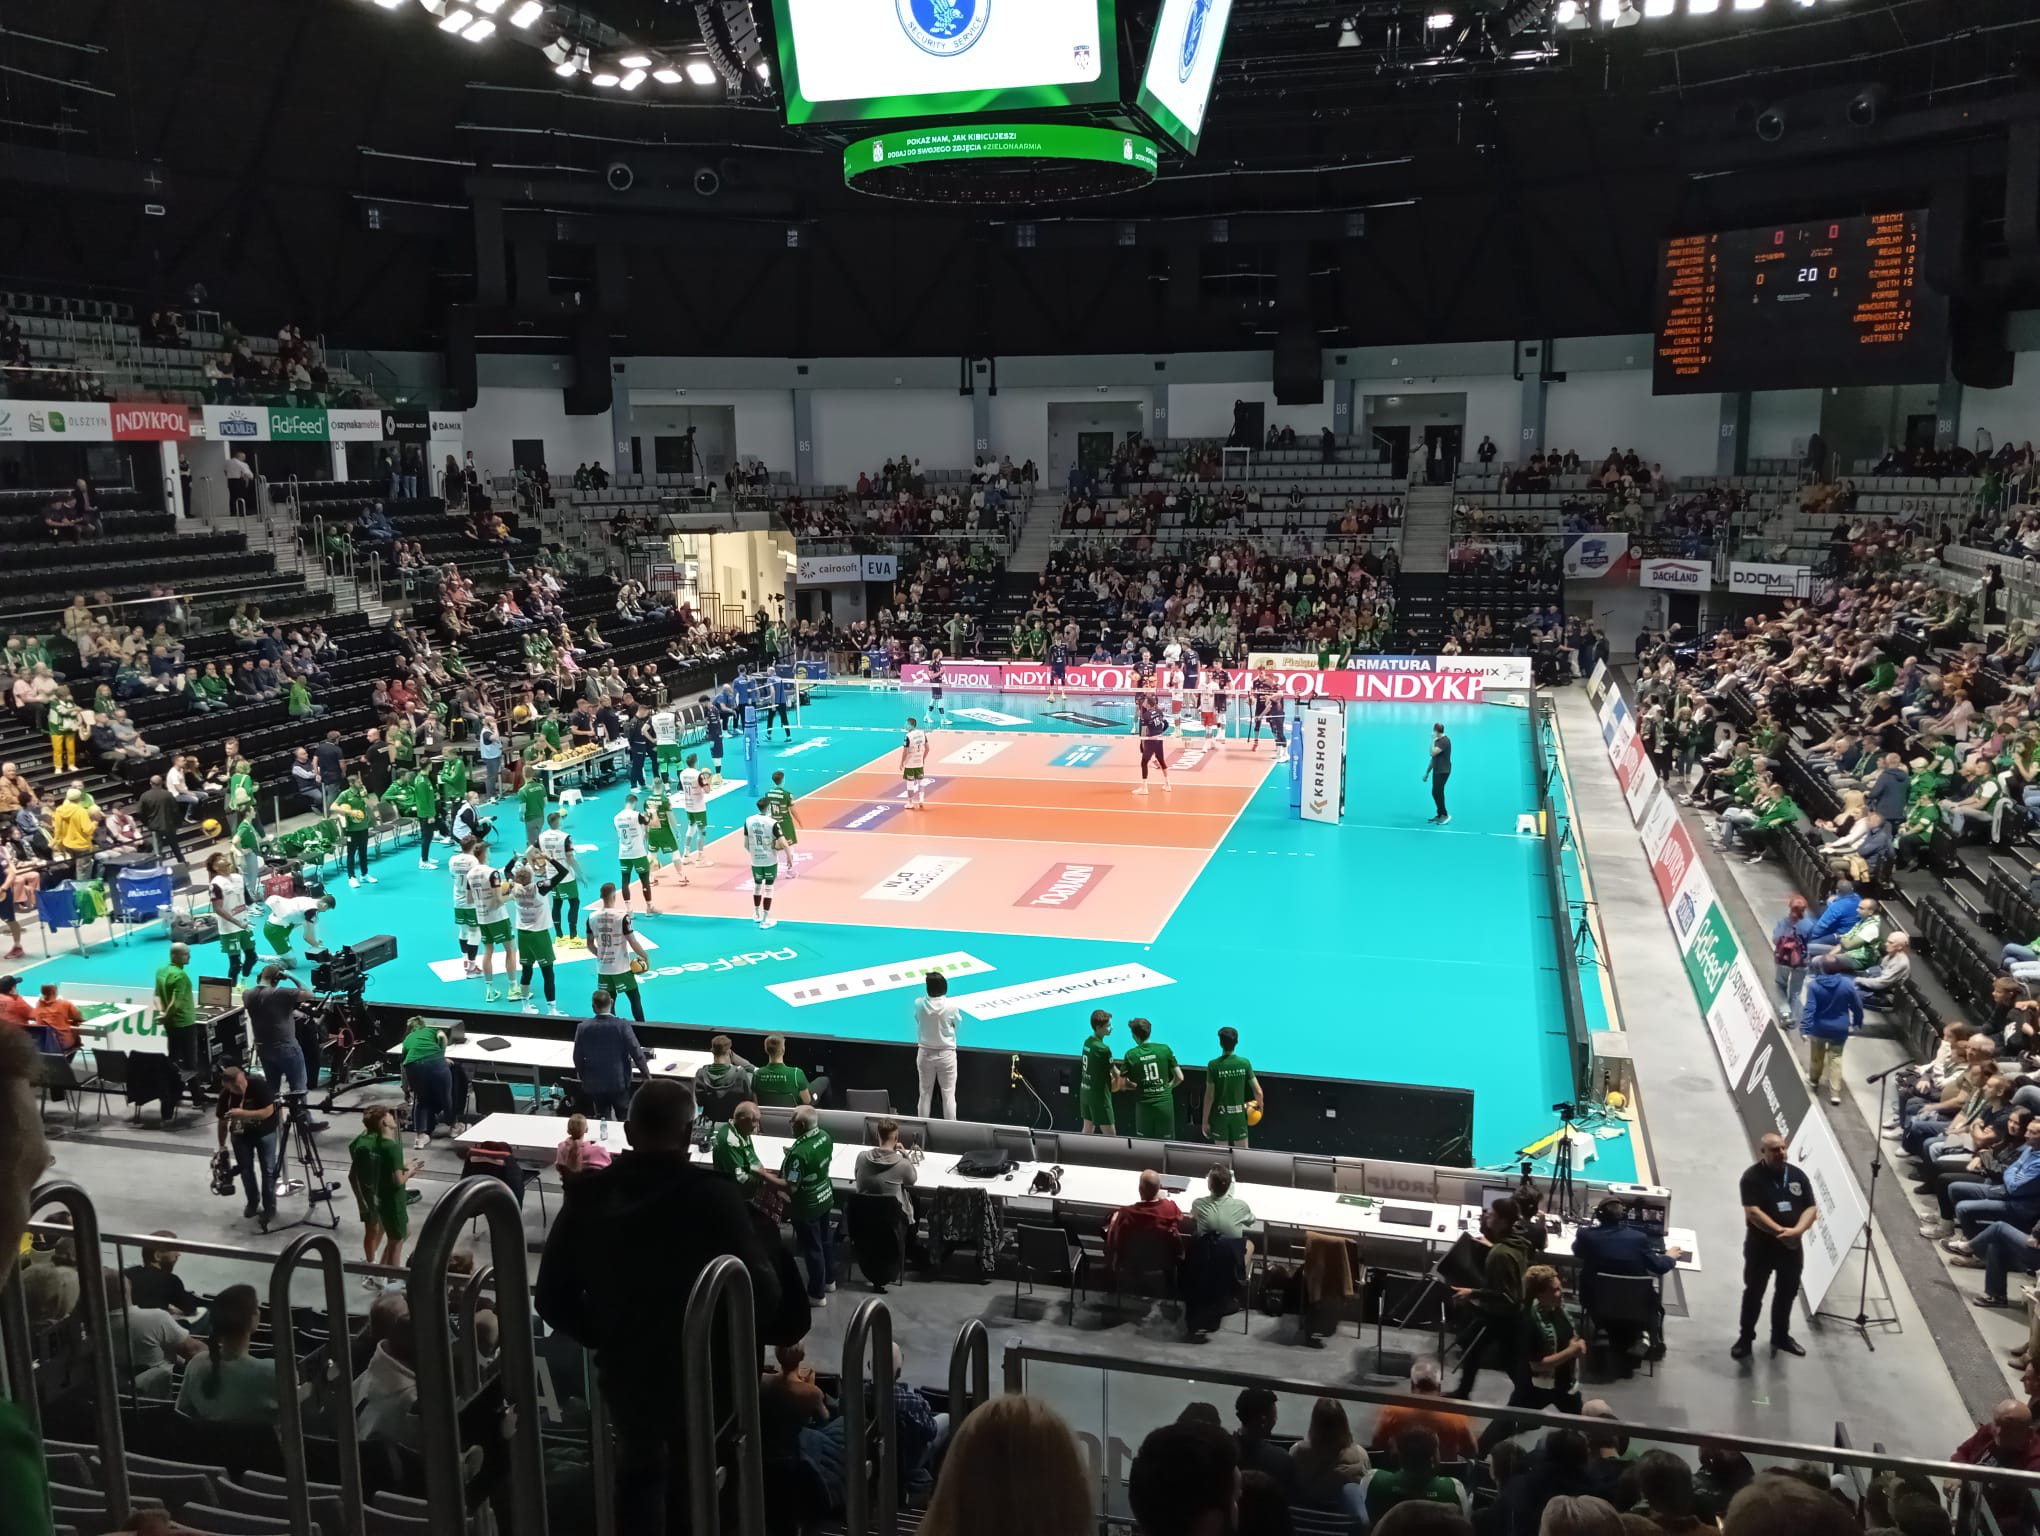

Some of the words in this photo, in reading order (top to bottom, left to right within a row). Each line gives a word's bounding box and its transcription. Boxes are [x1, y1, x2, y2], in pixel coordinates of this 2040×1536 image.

[908, 22, 946, 50] SECURITY
[953, 16, 984, 48] SERVICE
[951, 134, 966, 143] JAK
[1774, 231, 1784, 245] 0
[1829, 225, 1839, 239] 0
[1905, 245, 1916, 254] 10
[1756, 273, 1764, 285] 0
[1797, 267, 1818, 282] 20
[1829, 266, 1837, 279] 0
[1897, 322, 1911, 330] 22
[69, 416, 108, 427] OLSZTYN
[116, 410, 186, 433] INDYKPOL
[337, 418, 380, 433] szynakameble
[438, 422, 462, 431] DAMIX
[220, 423, 257, 435] POLMLEK
[819, 562, 858, 574] cairosoft
[868, 561, 891, 575] EVA
[1653, 570, 1698, 583] DACHLAND
[1733, 571, 1782, 585] D.DOM
[1346, 658, 1431, 671] ARMATURA
[1453, 666, 1499, 677] DAMIX
[938, 672, 990, 686] AURON
[1005, 670, 1089, 688] INDYPOL
[1314, 717, 1327, 798] KRISHOME
[1030, 865, 1094, 906] INDYKPOL
[1082, 1054, 1088, 1072] 9
[1142, 1061, 1159, 1081] 10
[1761, 1074, 1781, 1115] RENAULT
